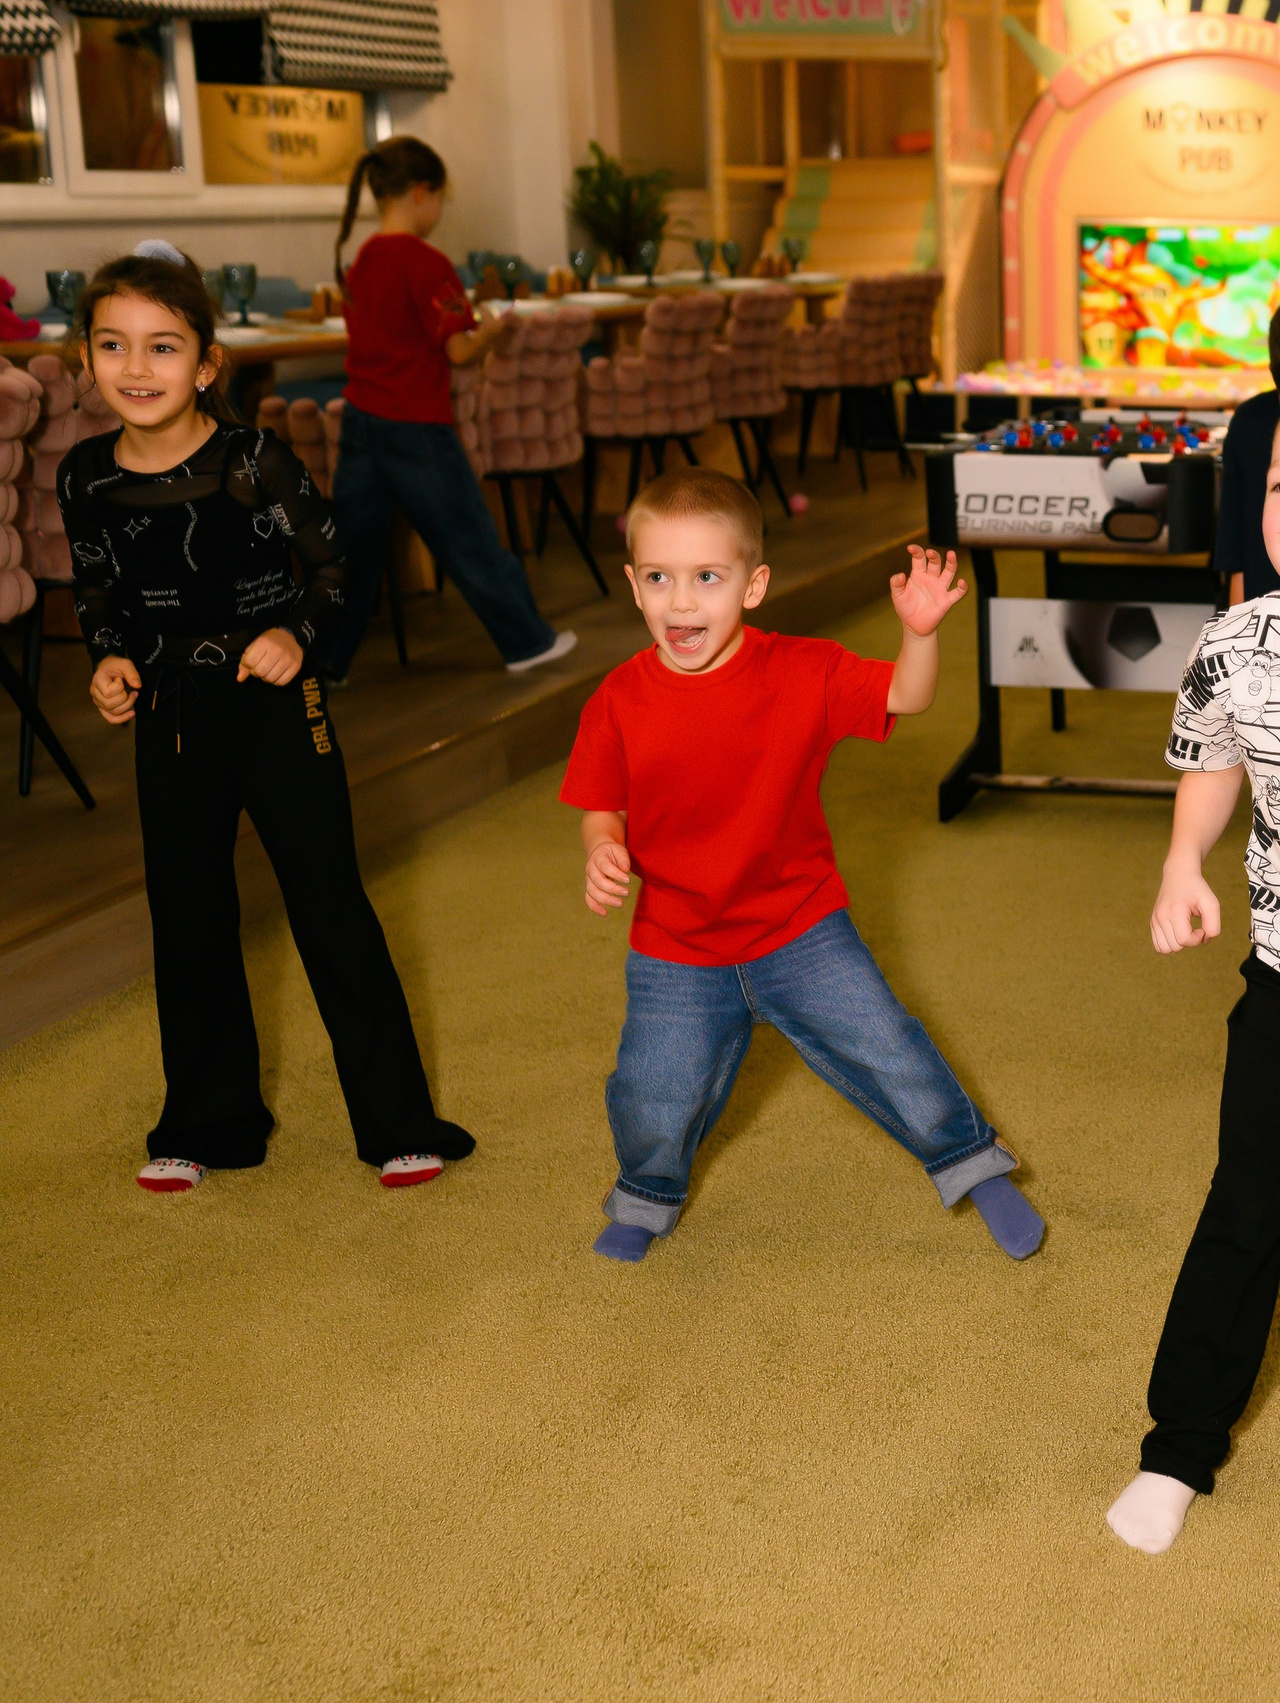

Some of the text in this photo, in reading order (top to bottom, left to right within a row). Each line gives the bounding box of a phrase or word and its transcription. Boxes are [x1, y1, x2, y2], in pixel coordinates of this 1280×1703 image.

[1143, 103, 1268, 133] MONKEY
[1180, 147, 1233, 171] PUB
[955, 493, 1098, 522] OCCER,
[302, 677, 332, 754] GRL PWR
